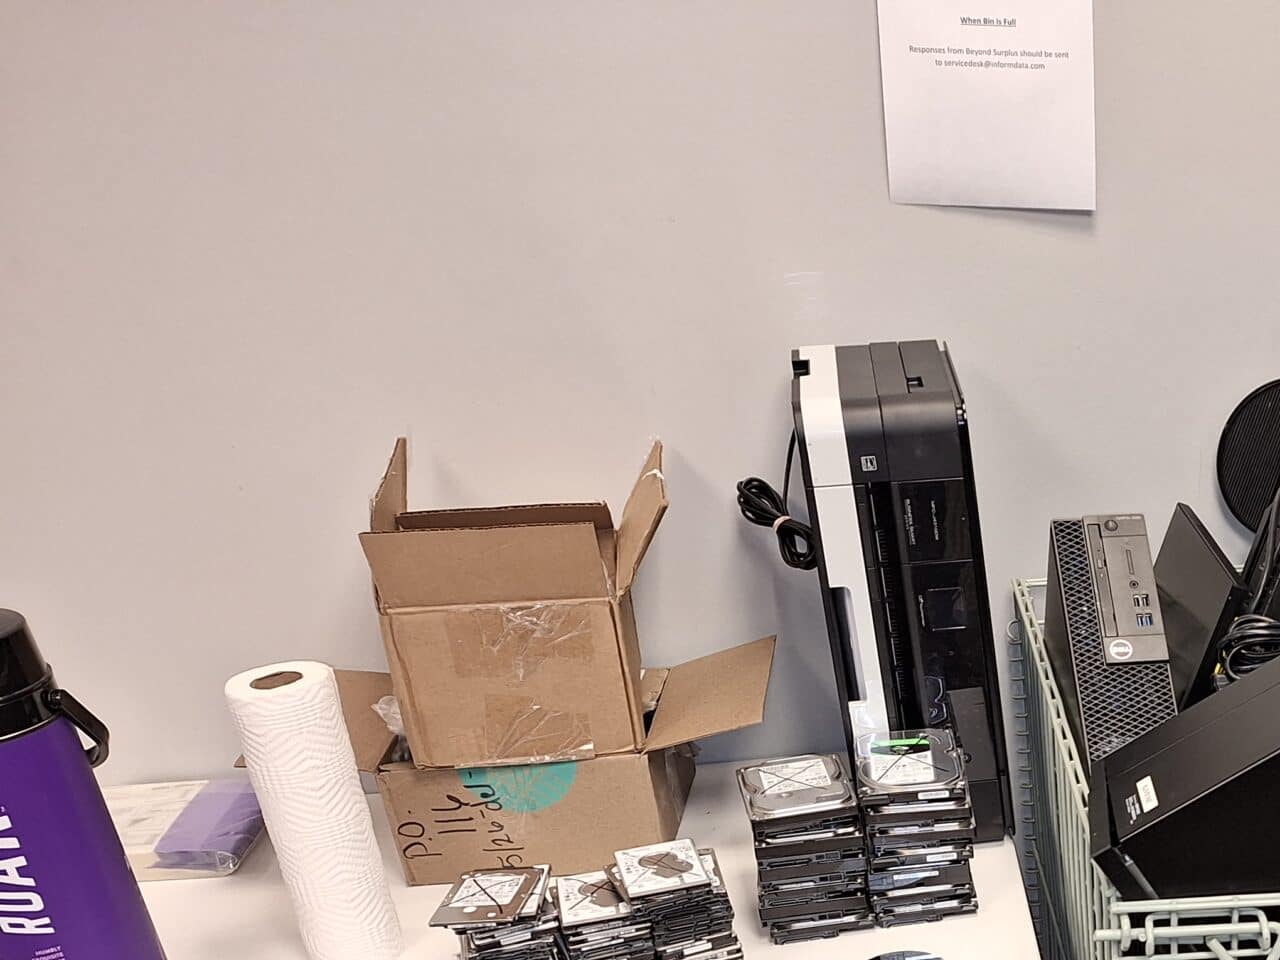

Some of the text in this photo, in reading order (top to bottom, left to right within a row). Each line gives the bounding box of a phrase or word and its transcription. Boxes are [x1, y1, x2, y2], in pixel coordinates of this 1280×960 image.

[960, 16, 982, 25] When
[983, 17, 995, 25] Bin
[1003, 18, 1017, 27] Full
[909, 45, 946, 56] Responses
[947, 46, 965, 55] from
[966, 47, 992, 57] Beyond
[993, 48, 1019, 58] Surplus
[1019, 49, 1043, 58] should
[1044, 50, 1054, 58] be
[944, 59, 1046, 70] servicedesk@informdata.com
